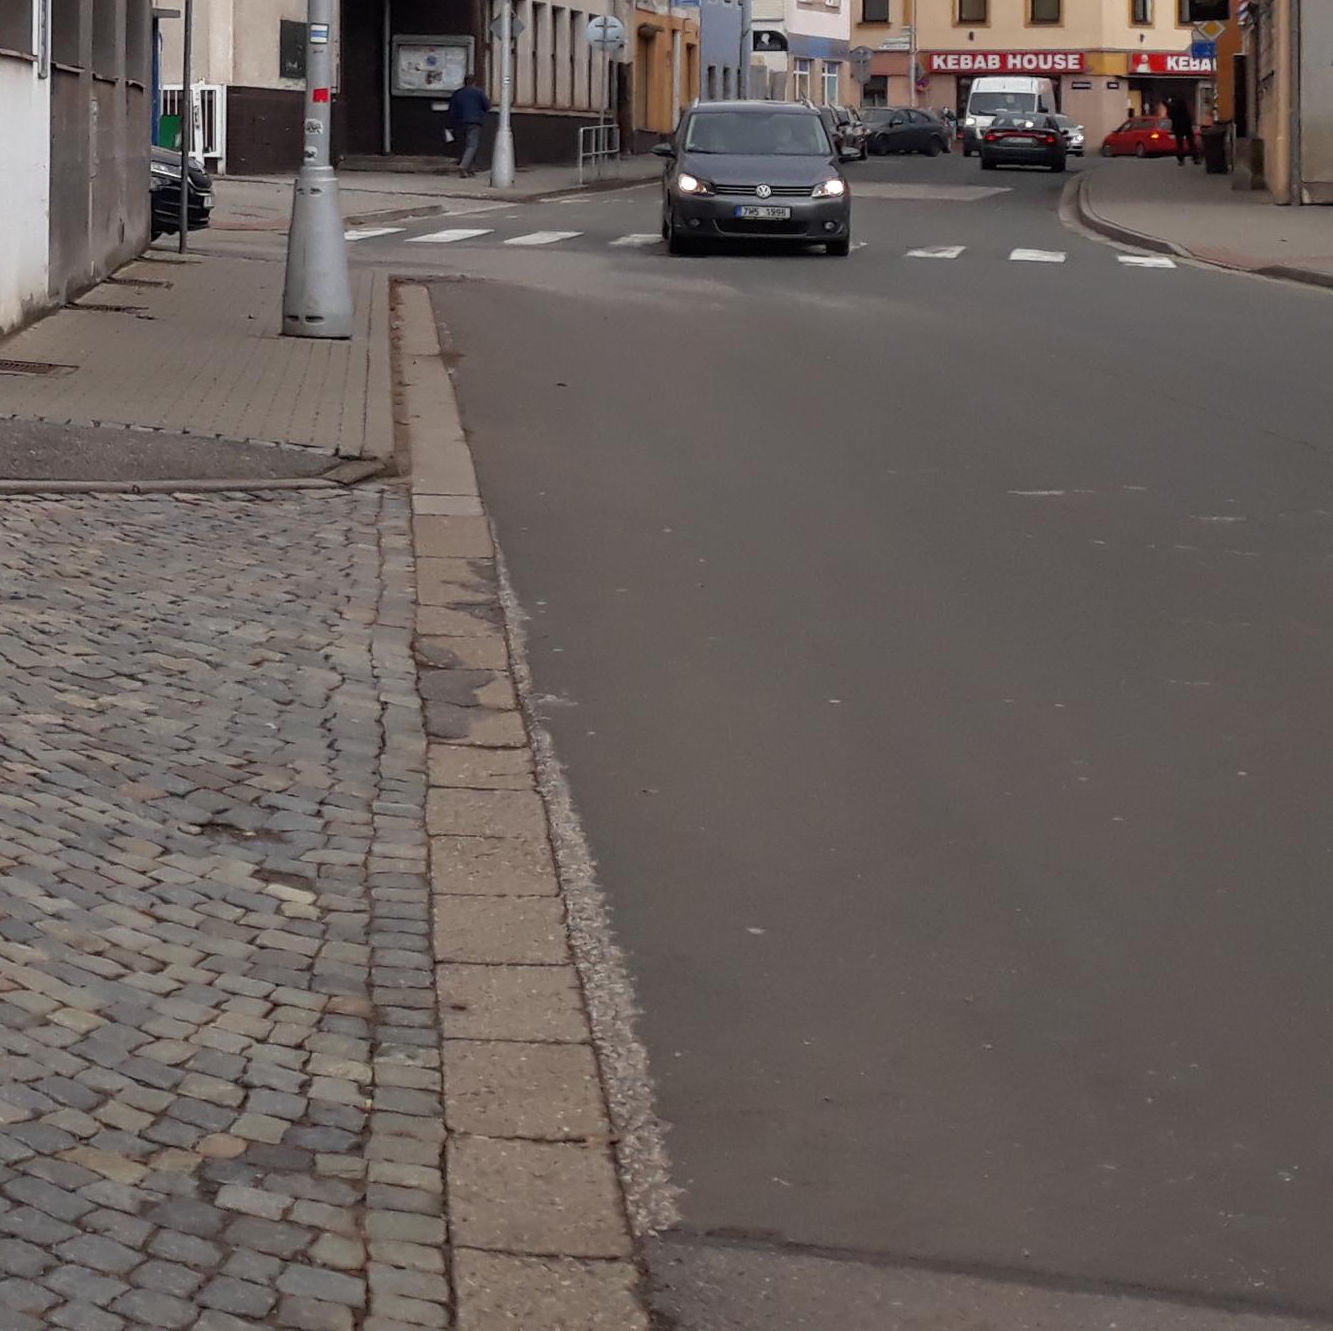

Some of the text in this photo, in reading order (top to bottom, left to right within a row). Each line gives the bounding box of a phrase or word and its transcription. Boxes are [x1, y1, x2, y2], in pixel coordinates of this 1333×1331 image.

[933, 53, 1081, 70] KEBAB HOUSE
[1166, 57, 1217, 72] KEBA
